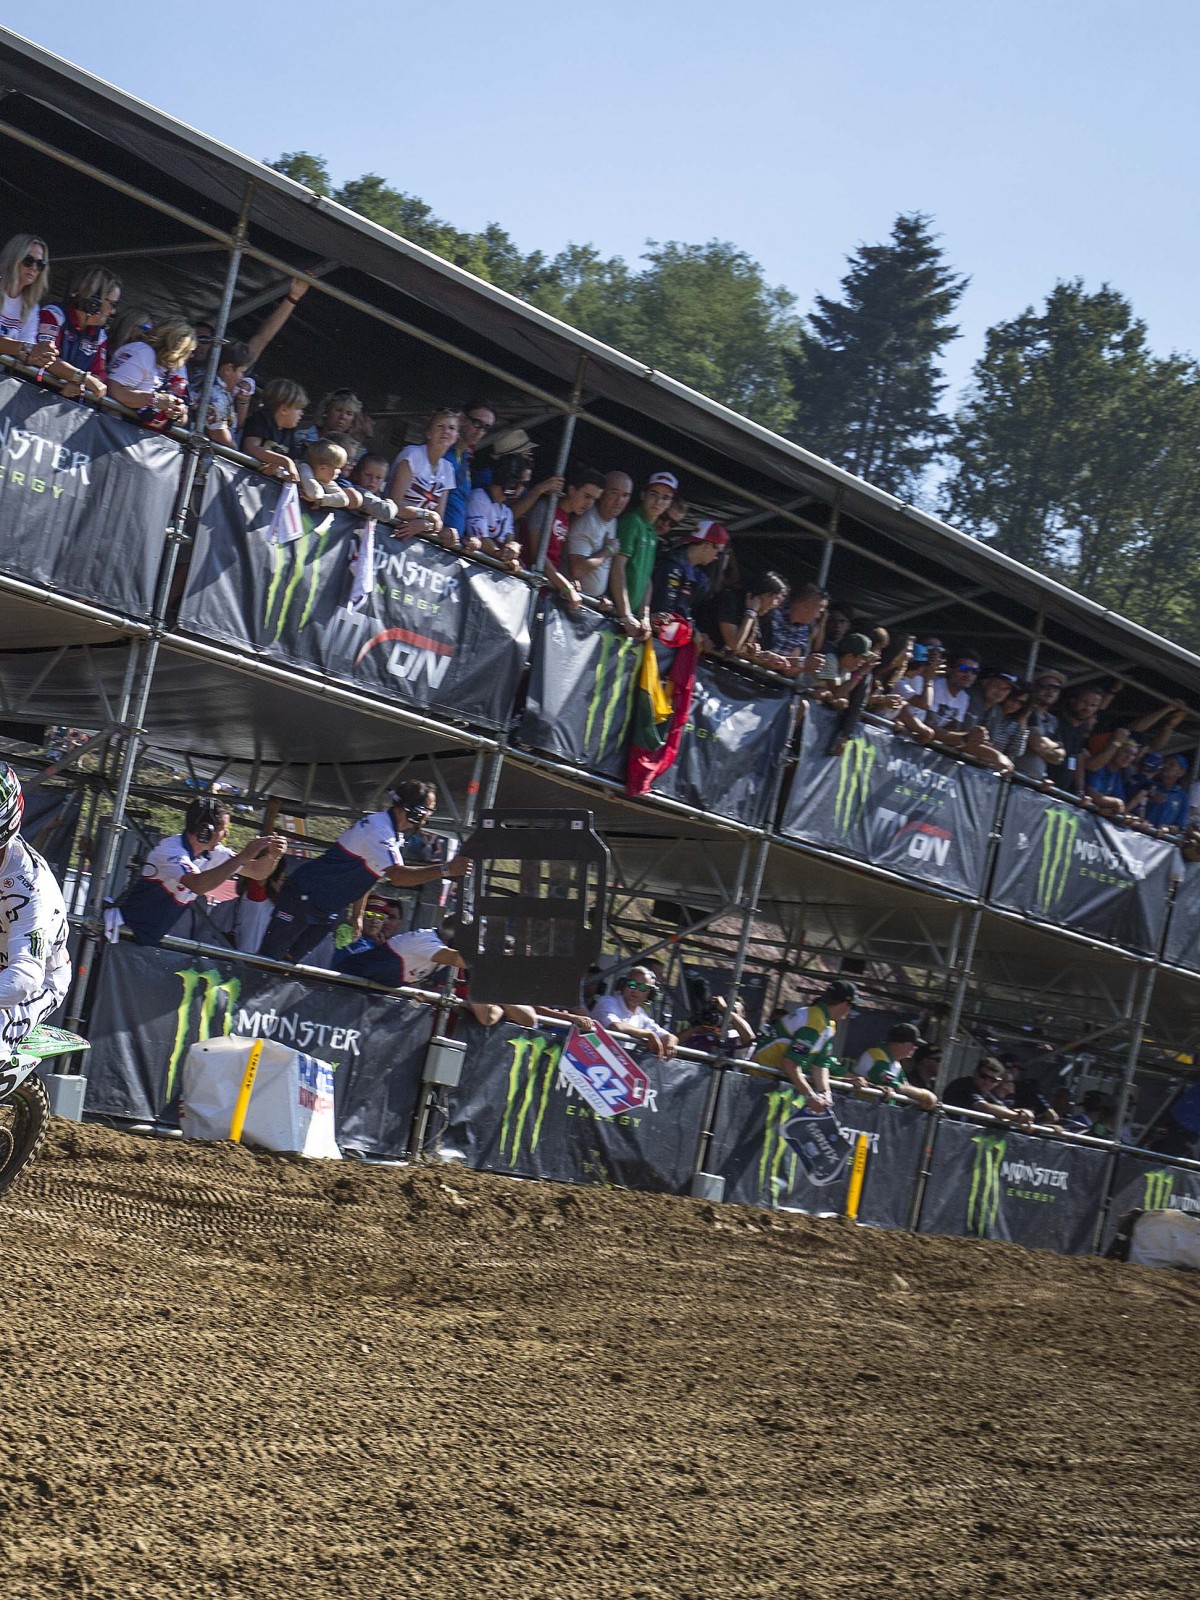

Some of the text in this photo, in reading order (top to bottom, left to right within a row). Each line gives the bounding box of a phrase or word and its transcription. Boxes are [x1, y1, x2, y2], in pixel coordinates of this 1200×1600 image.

[375, 583, 440, 614] NERGY
[237, 1008, 362, 1056] MONSTER
[586, 1065, 629, 1106] 42
[1001, 1160, 1069, 1190] MONSTER
